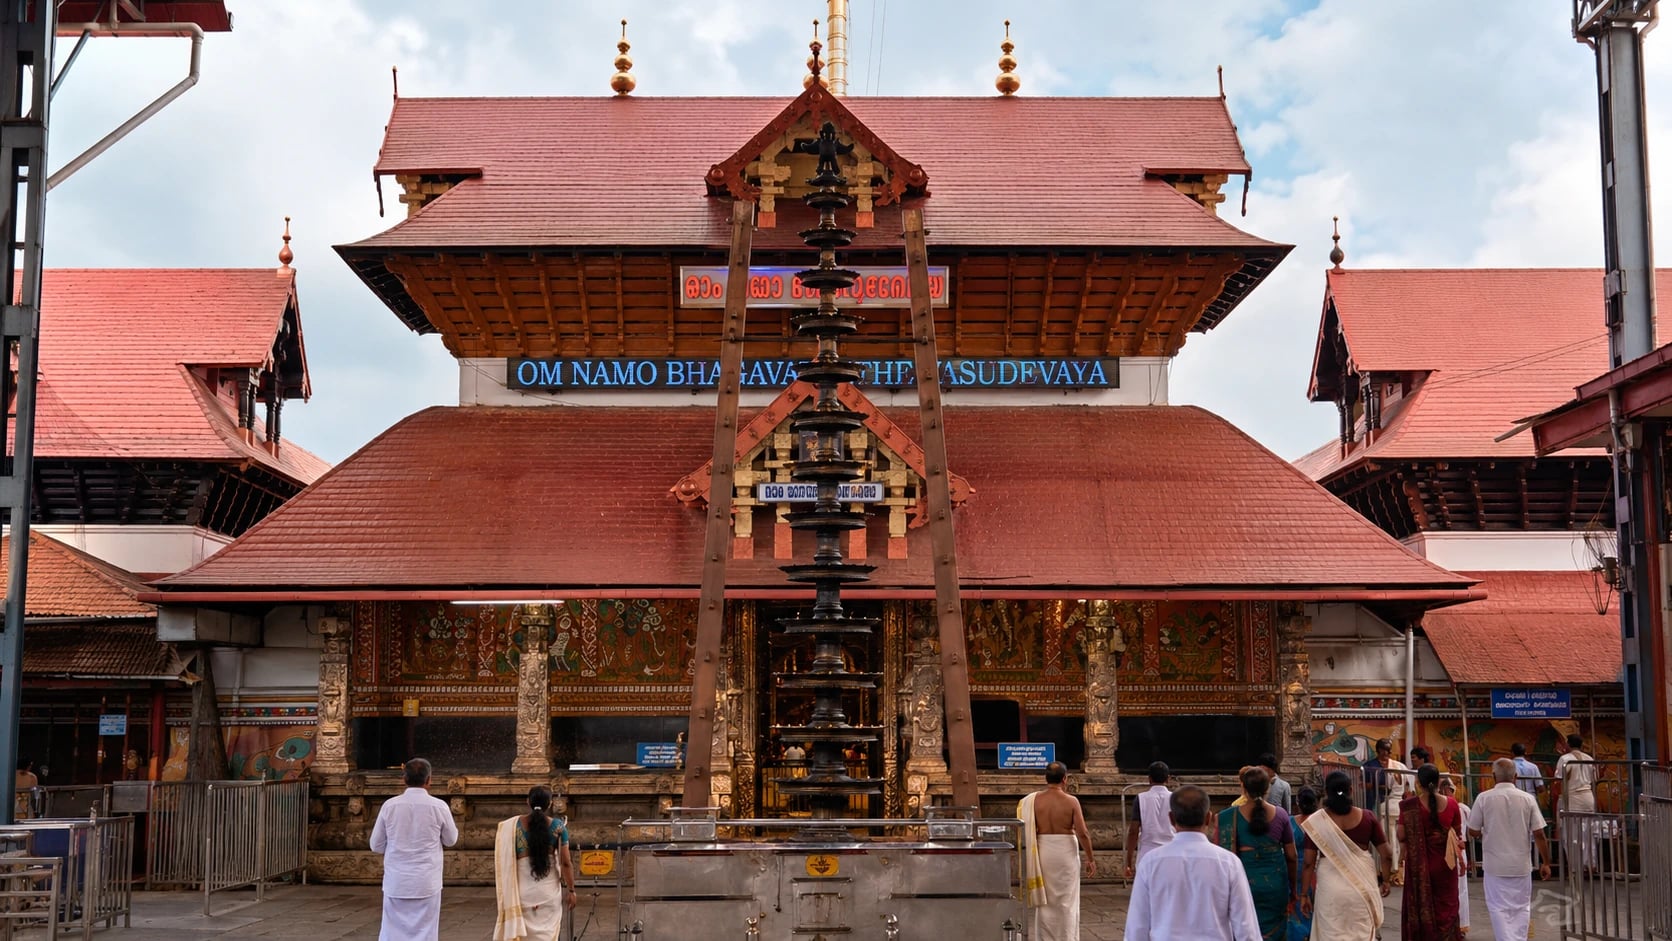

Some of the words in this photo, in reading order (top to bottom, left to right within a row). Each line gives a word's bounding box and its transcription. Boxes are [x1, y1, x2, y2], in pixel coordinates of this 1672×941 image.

[517, 361, 563, 386] OM
[571, 361, 658, 386] NAMO
[937, 360, 1108, 385] ASUDEVAYA
